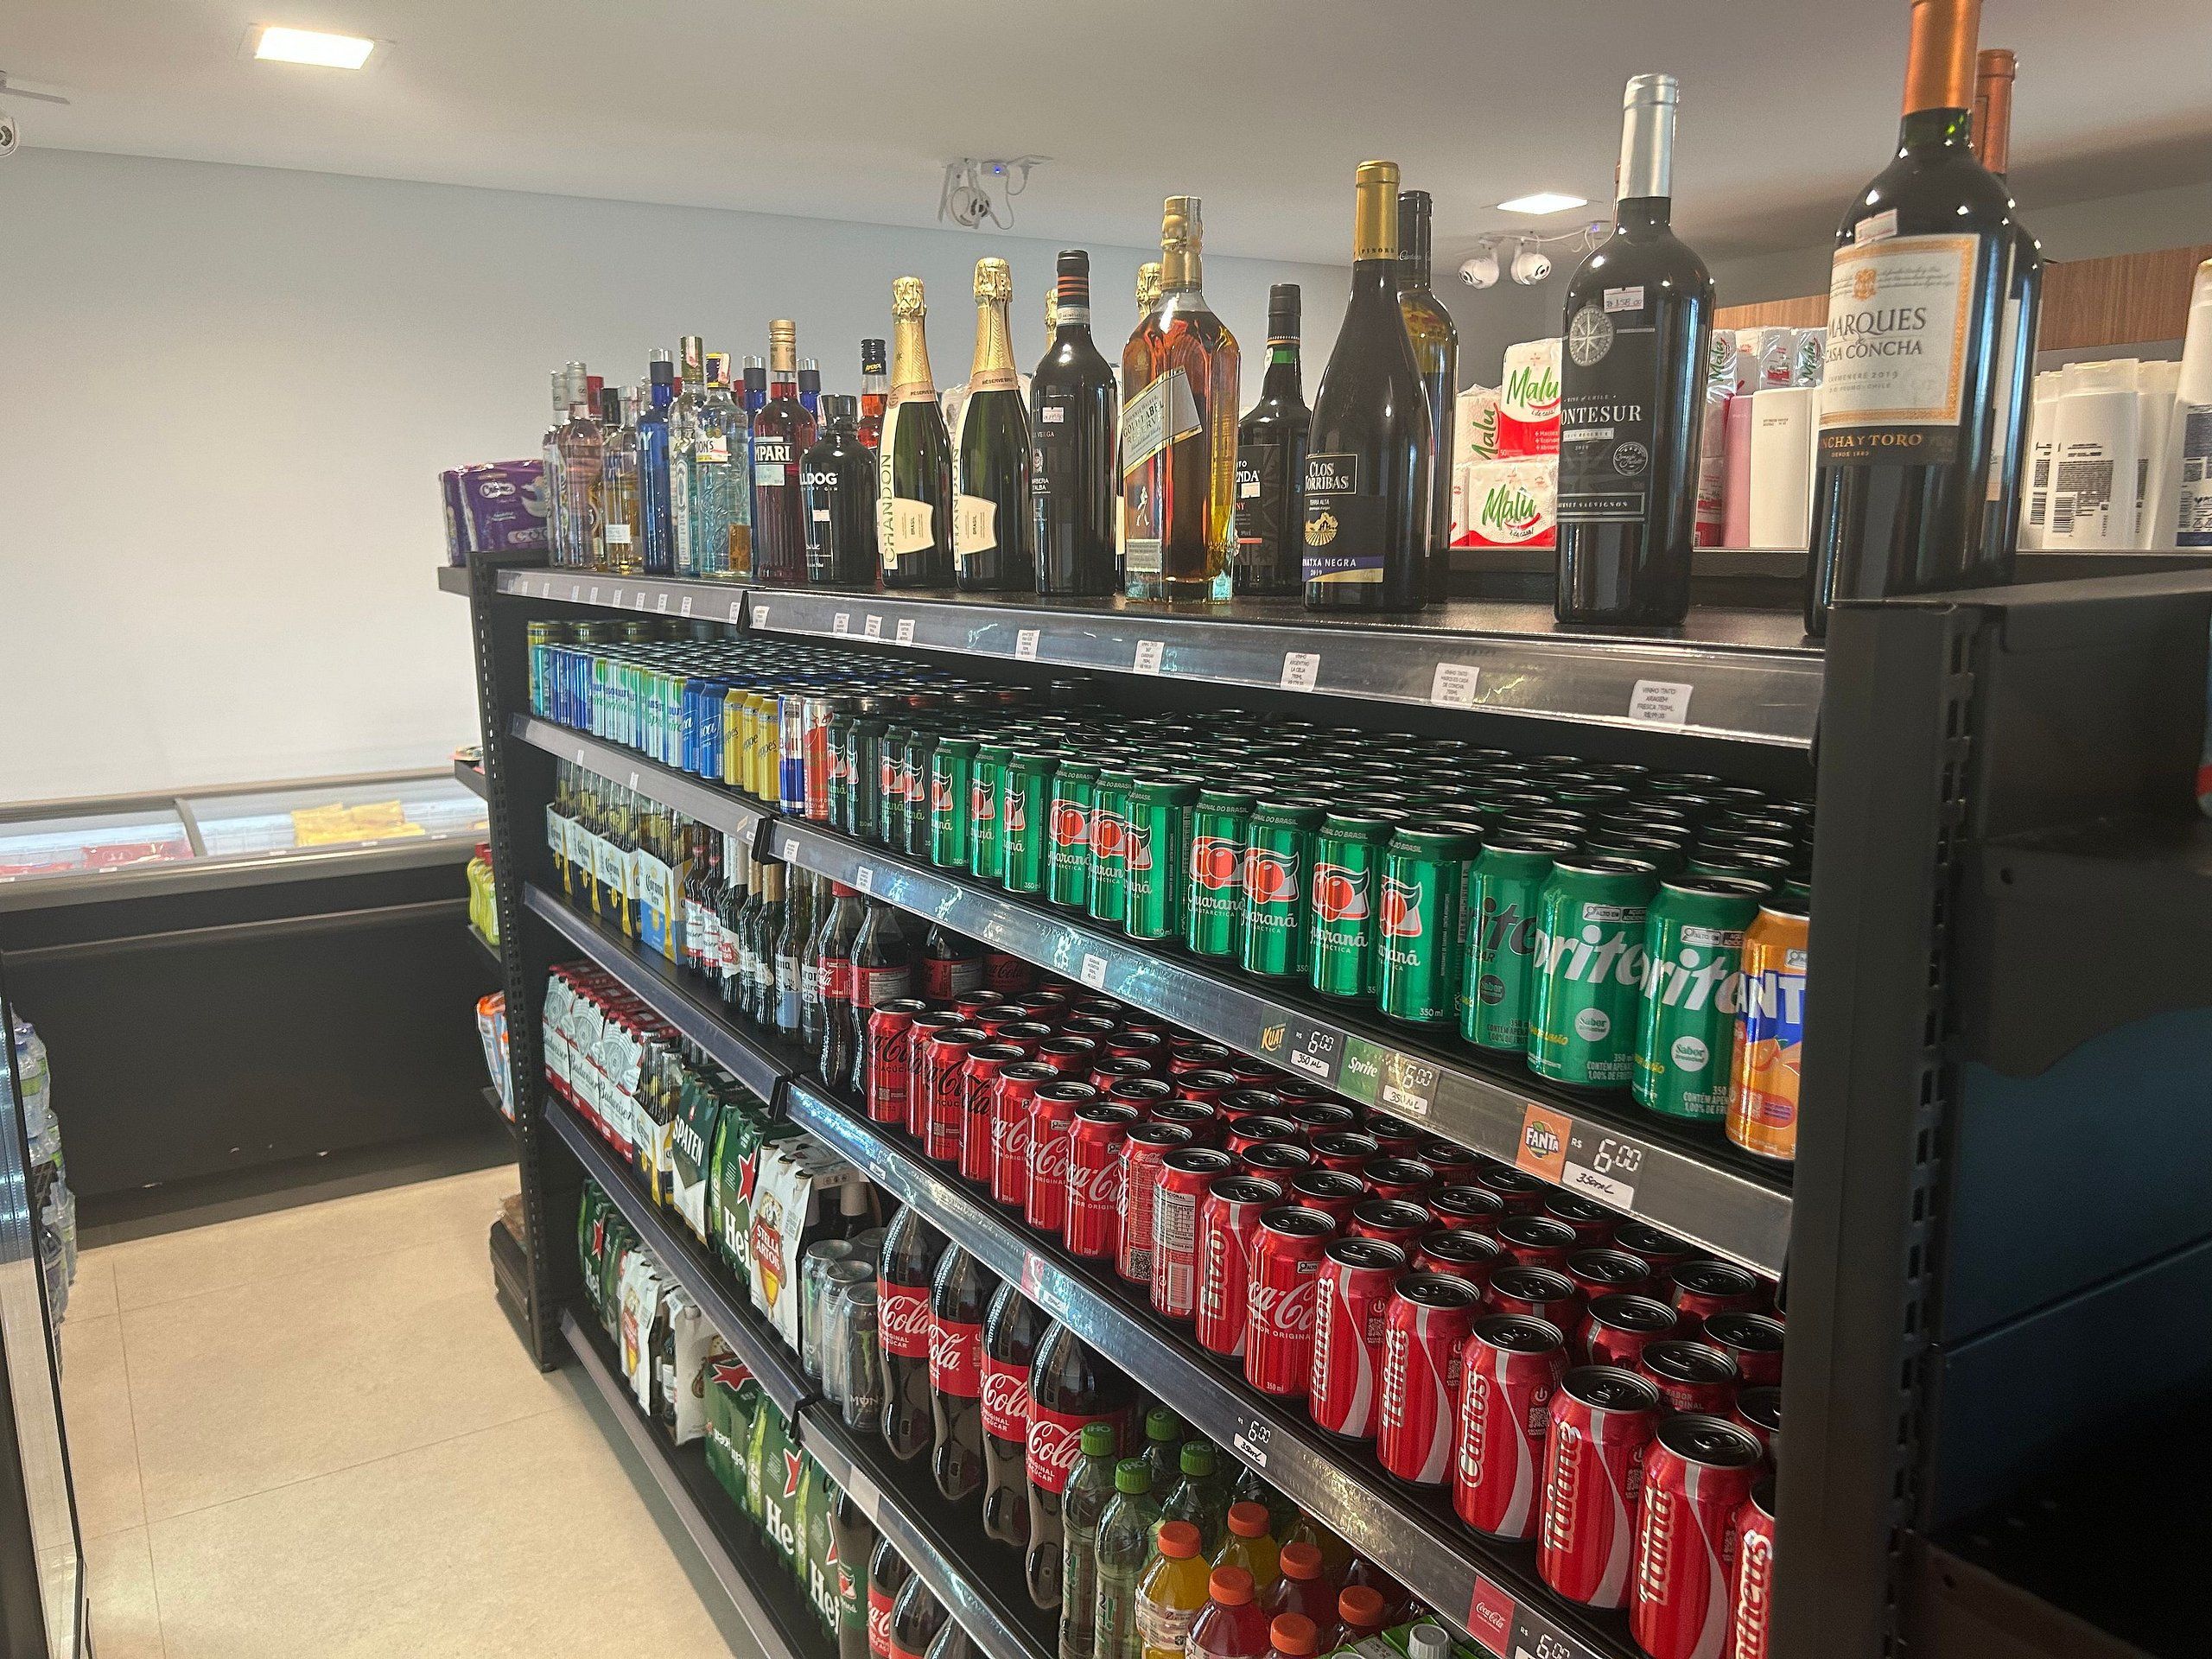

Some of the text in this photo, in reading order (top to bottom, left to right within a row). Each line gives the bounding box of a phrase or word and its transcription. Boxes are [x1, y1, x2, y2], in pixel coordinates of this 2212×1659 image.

[1846, 340, 1923, 359] CONCHA
[1506, 366, 1559, 408] Malu
[1560, 405, 1643, 425] ONTESUR
[1822, 435, 1856, 448] NCHA
[1868, 434, 1923, 447] TORO
[1309, 461, 1335, 477] CLOS
[880, 454, 895, 563] CHANDON
[1482, 484, 1535, 531] Malu
[1325, 558, 1357, 567] NEGRA
[1275, 815, 1299, 825] BRASIL
[1343, 831, 1369, 841] BRASIL
[1534, 925, 1644, 986] prite
[1296, 963, 1309, 973] 350
[1736, 969, 1807, 1025] ANT
[1420, 1007, 1444, 1018] 350 ml
[1580, 1015, 1607, 1027] Sabor
[1260, 1026, 1287, 1052] KUAT
[1613, 1053, 1626, 1063] 350
[1675, 1042, 1704, 1058] Sabor
[1346, 1055, 1379, 1078] Sprite
[1608, 1062, 1634, 1071] APENA
[1682, 1091, 1713, 1103] CONTÉM
[1712, 1085, 1727, 1096] 350
[672, 1115, 705, 1166] SPATEN
[1524, 1126, 1560, 1153] FANTA
[1273, 1328, 1315, 1341] ORIGINA
[1266, 1381, 1276, 1391] 350
[1459, 1370, 1492, 1490] Carlos
